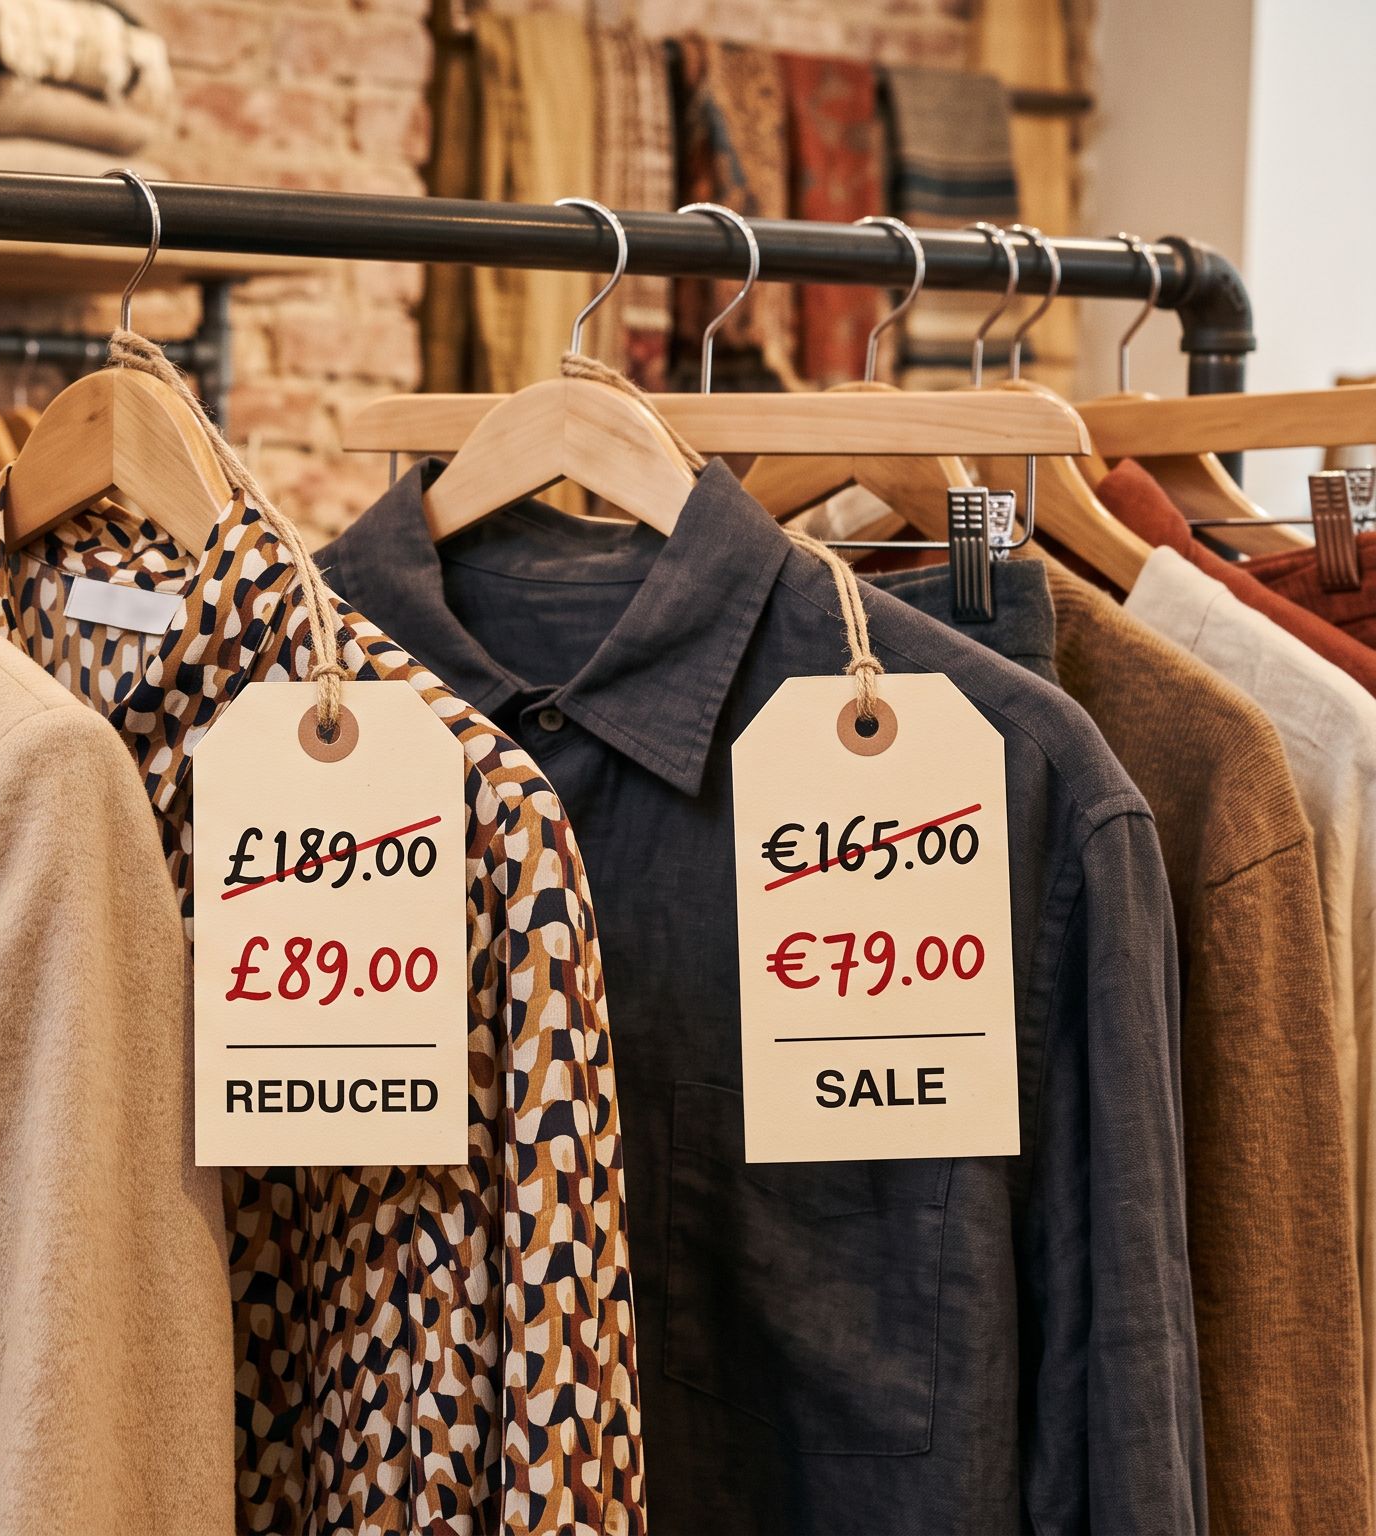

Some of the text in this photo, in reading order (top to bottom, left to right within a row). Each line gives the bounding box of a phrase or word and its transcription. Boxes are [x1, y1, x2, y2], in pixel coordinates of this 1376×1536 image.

[223, 827, 437, 889] £189.00
[761, 815, 979, 881] €165.00
[225, 935, 438, 1006] £89.00
[766, 930, 985, 998] €79.00
[226, 1078, 439, 1114] REDUCED
[815, 1067, 947, 1109] SALE
